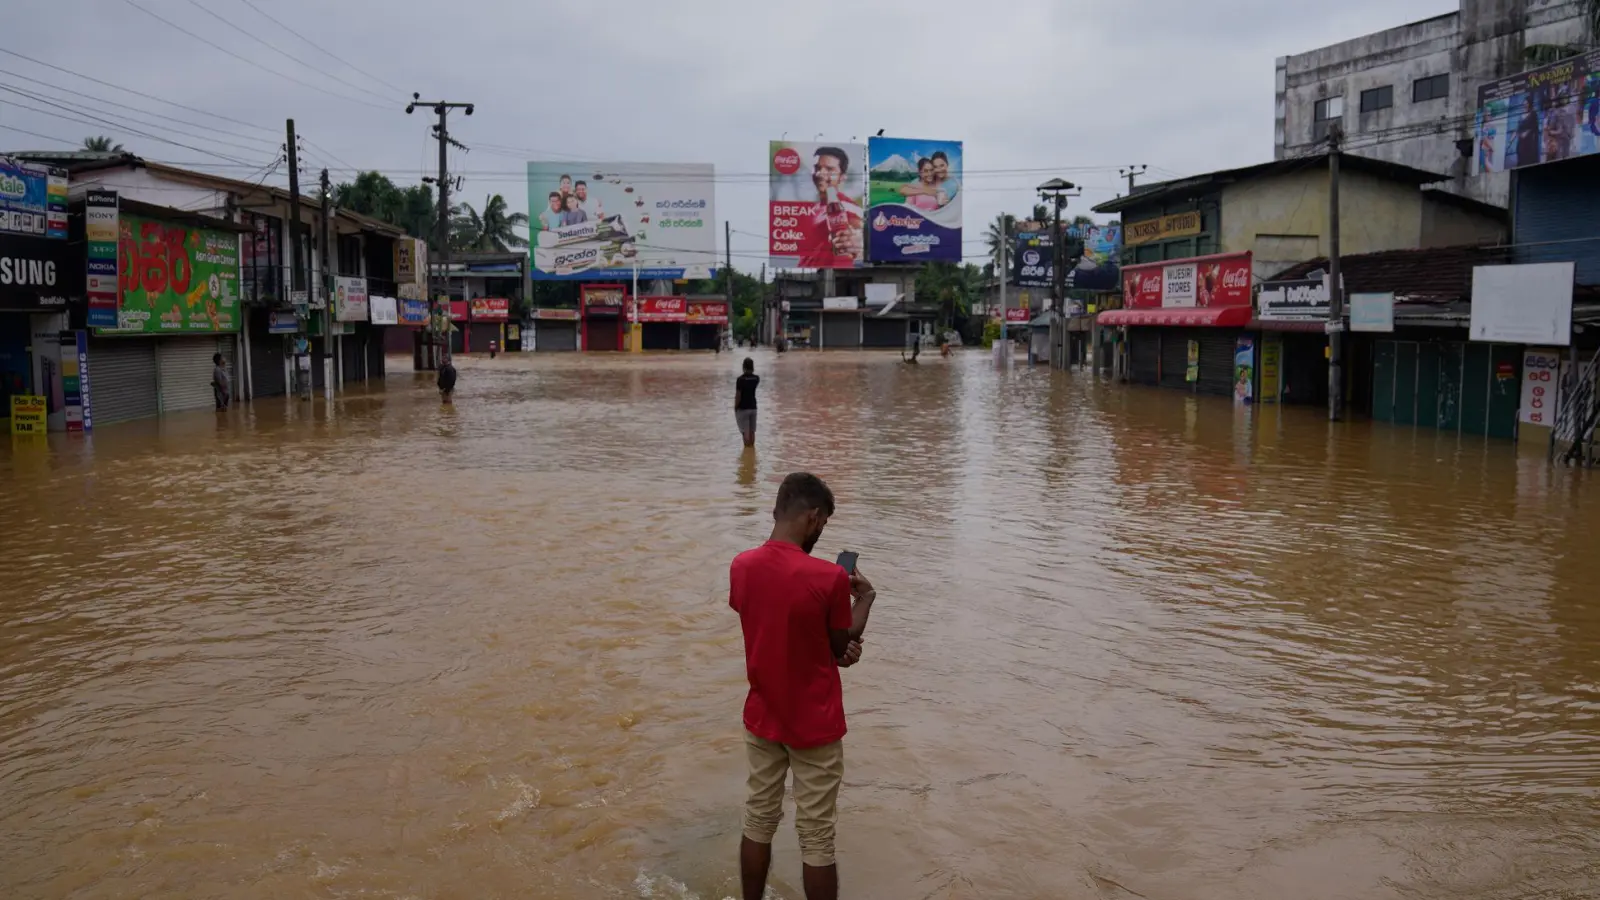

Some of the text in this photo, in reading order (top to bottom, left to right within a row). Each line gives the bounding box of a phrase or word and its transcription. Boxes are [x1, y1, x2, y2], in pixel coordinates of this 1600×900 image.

[773, 205, 816, 217] BREAK
[773, 229, 806, 240] Coke
[89, 263, 115, 271] NOKIA
[1168, 268, 1193, 283] WIJESIRI
[1222, 268, 1249, 289] Coca-Cola
[1142, 275, 1161, 293] Coca-Cola
[1168, 282, 1192, 294] STORES
[80, 352, 91, 428] SAMSUNG
